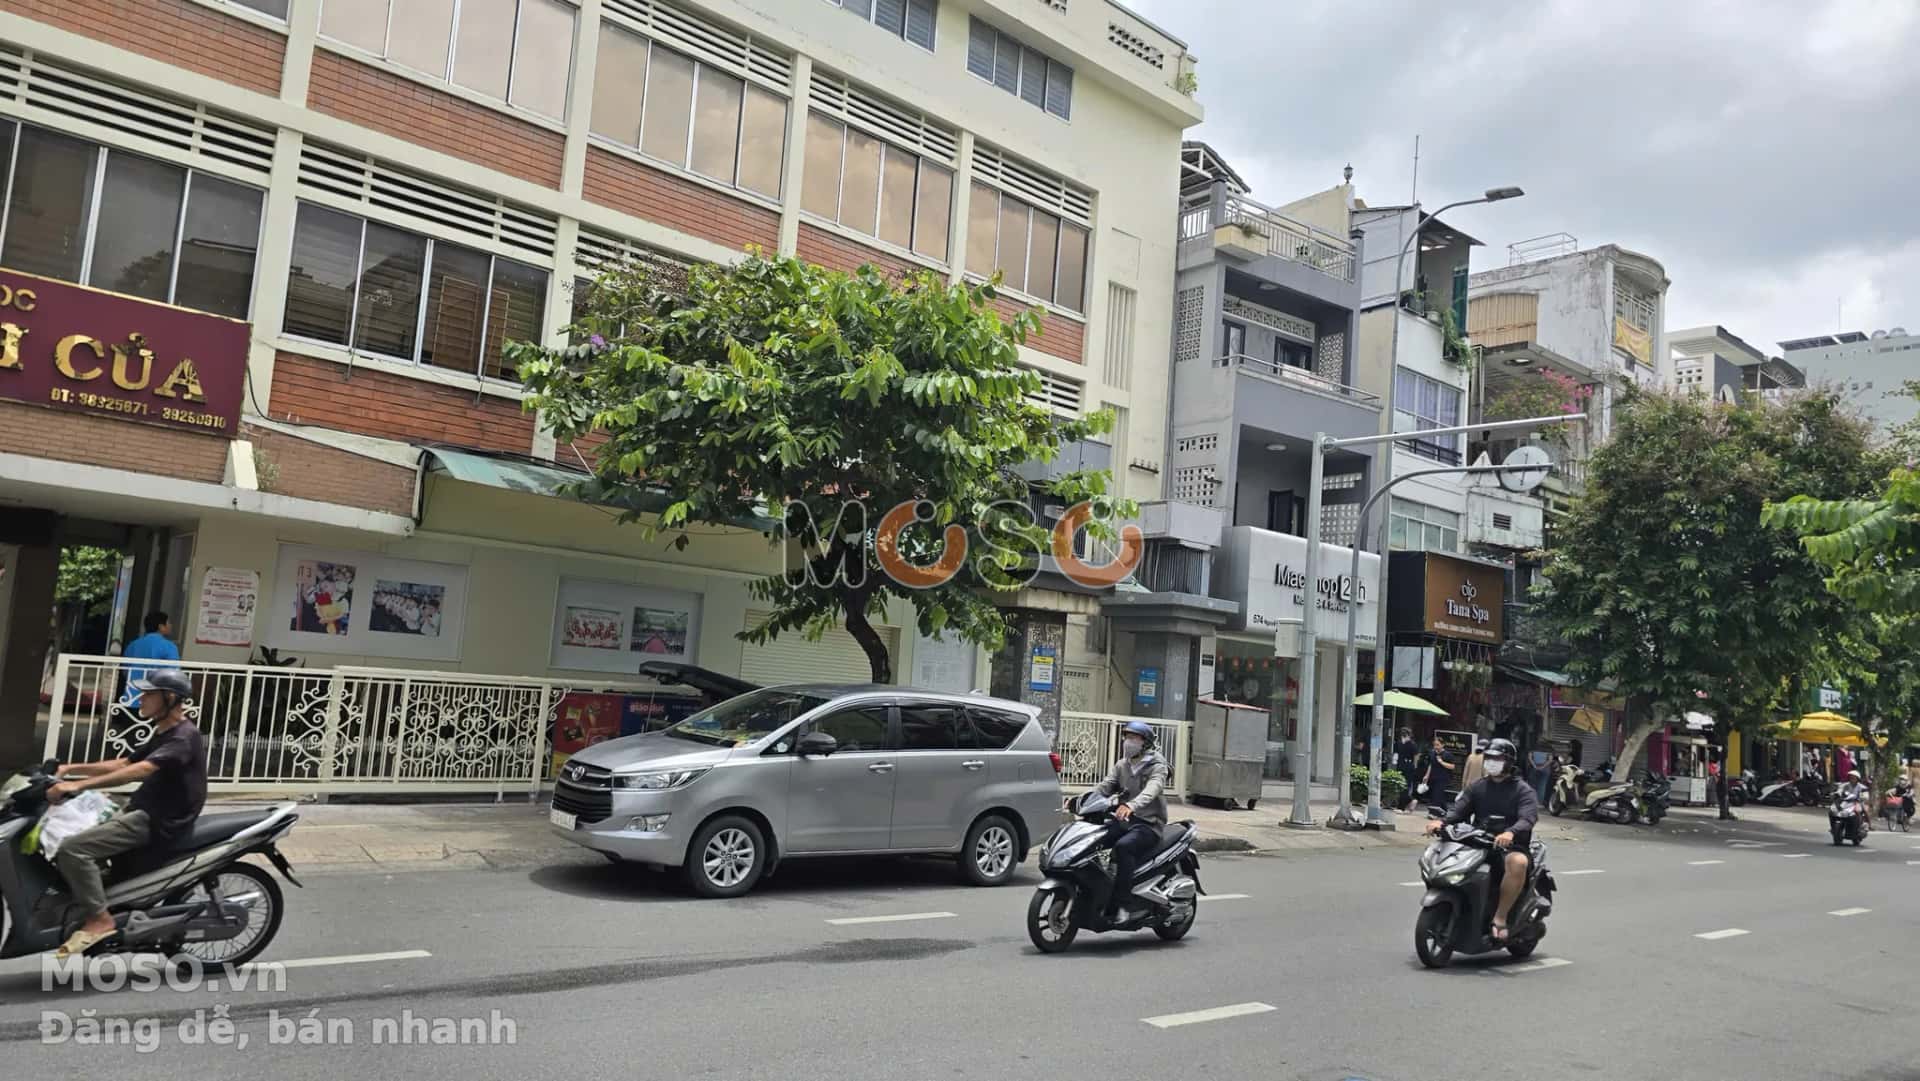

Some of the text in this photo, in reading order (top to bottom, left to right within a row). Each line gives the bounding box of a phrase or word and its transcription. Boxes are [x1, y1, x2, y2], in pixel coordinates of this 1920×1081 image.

[1274, 563, 1367, 601] Macop 2h
[1446, 598, 1489, 624] Tana Spa
